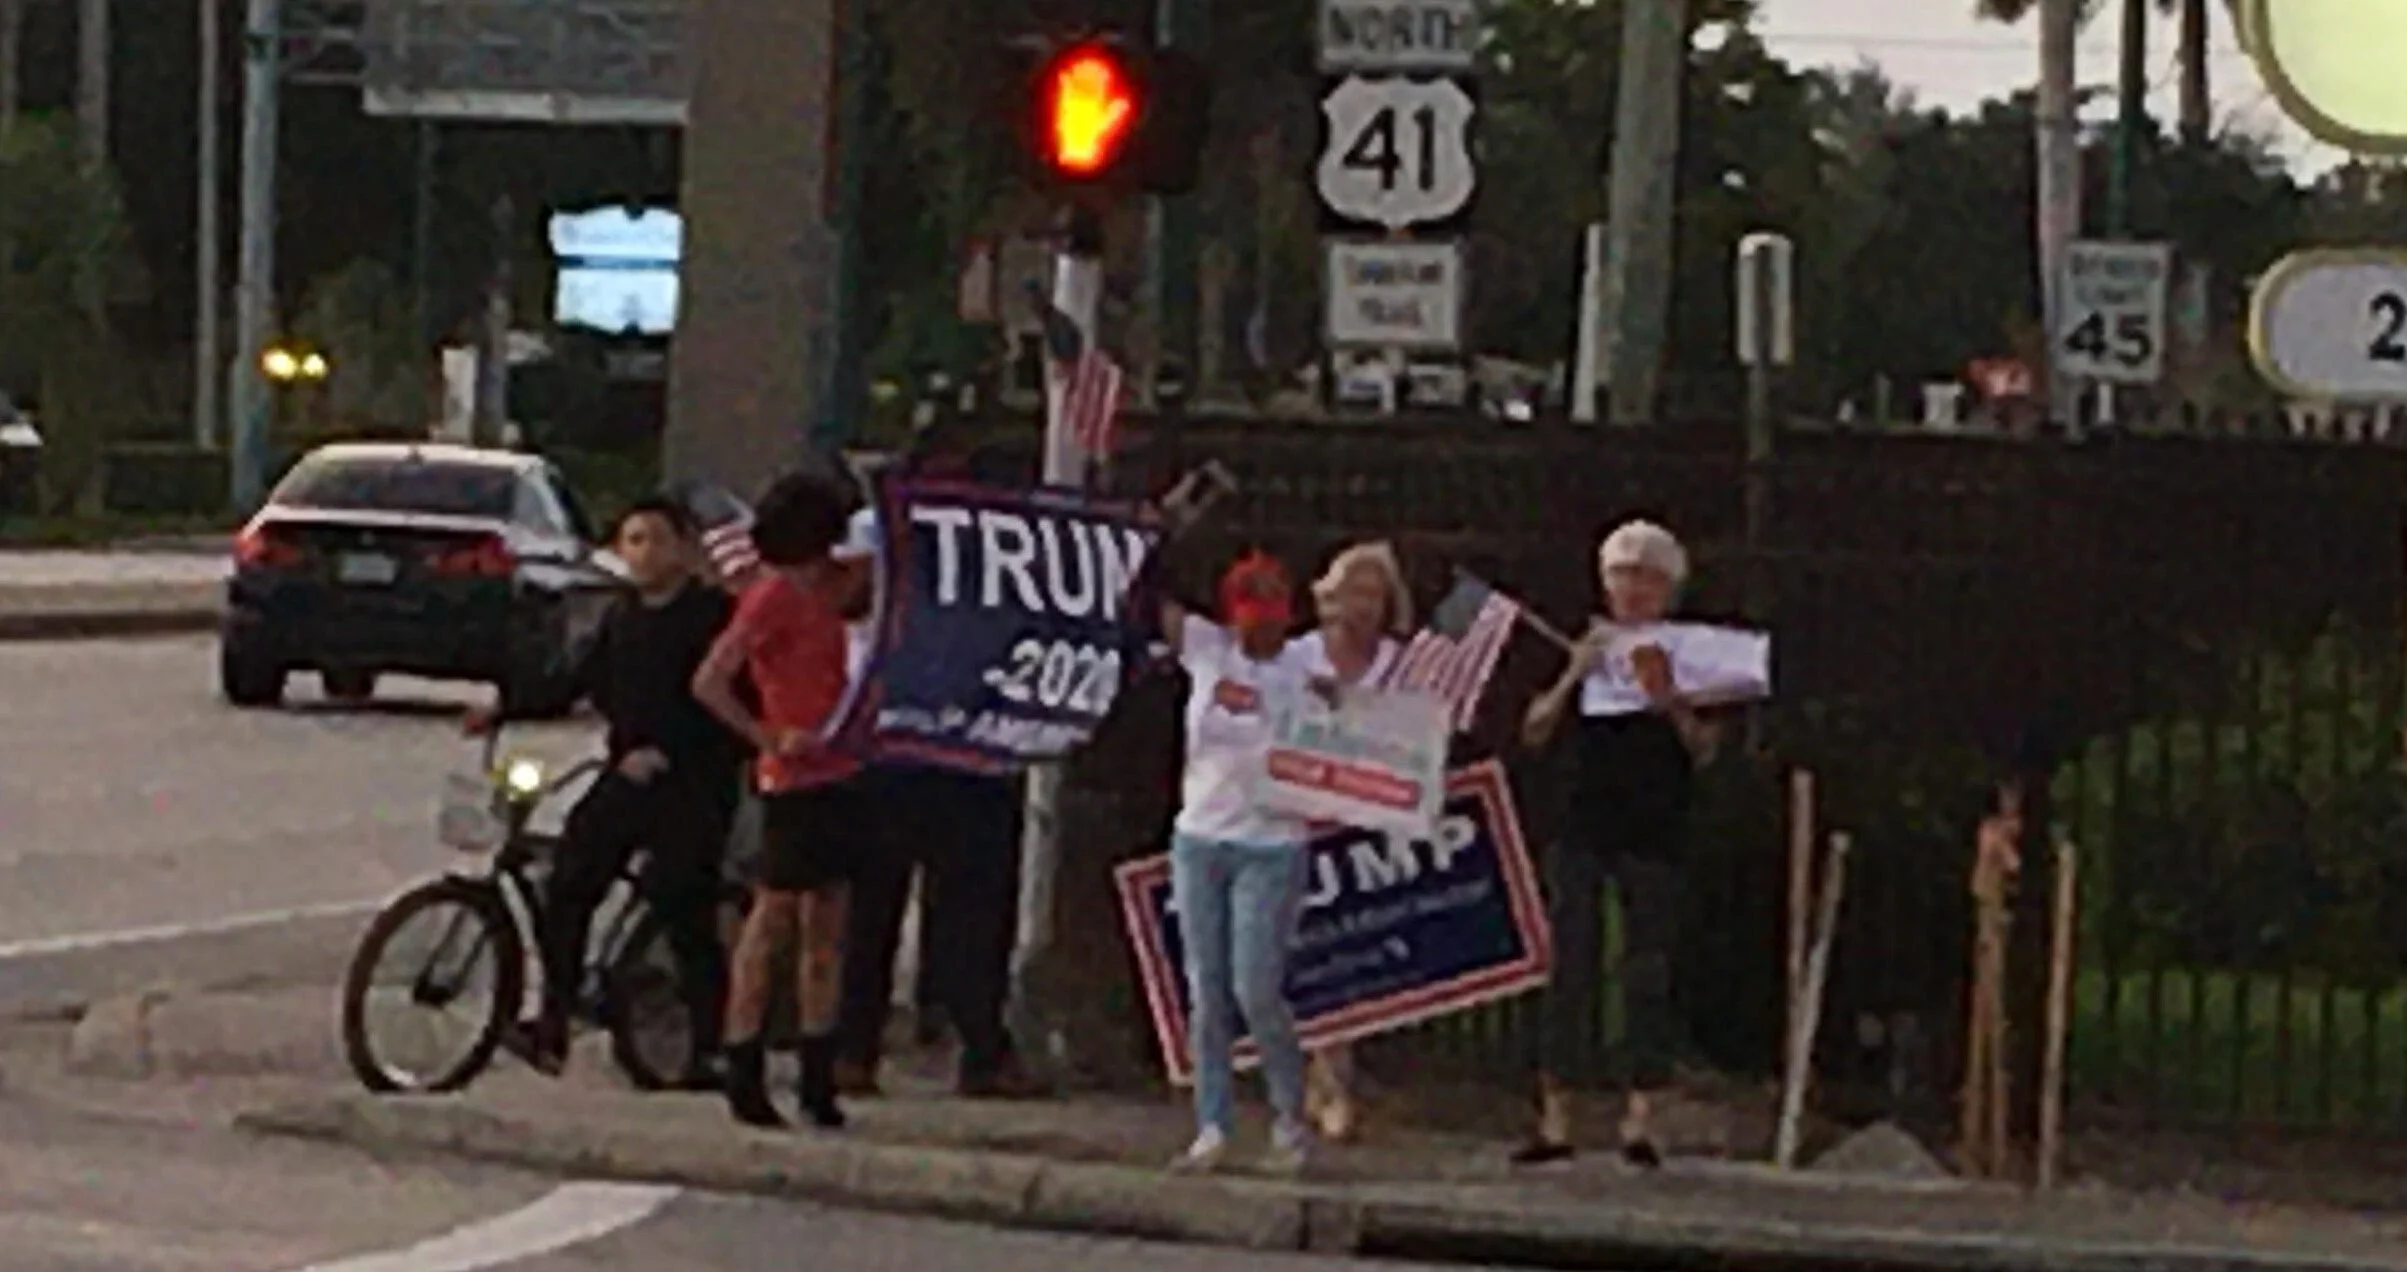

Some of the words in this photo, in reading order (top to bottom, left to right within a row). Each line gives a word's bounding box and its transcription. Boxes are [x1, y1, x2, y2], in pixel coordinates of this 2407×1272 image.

[1343, 105, 1435, 191] 41
[2064, 311, 2152, 367] 45
[2369, 292, 2406, 361] 2
